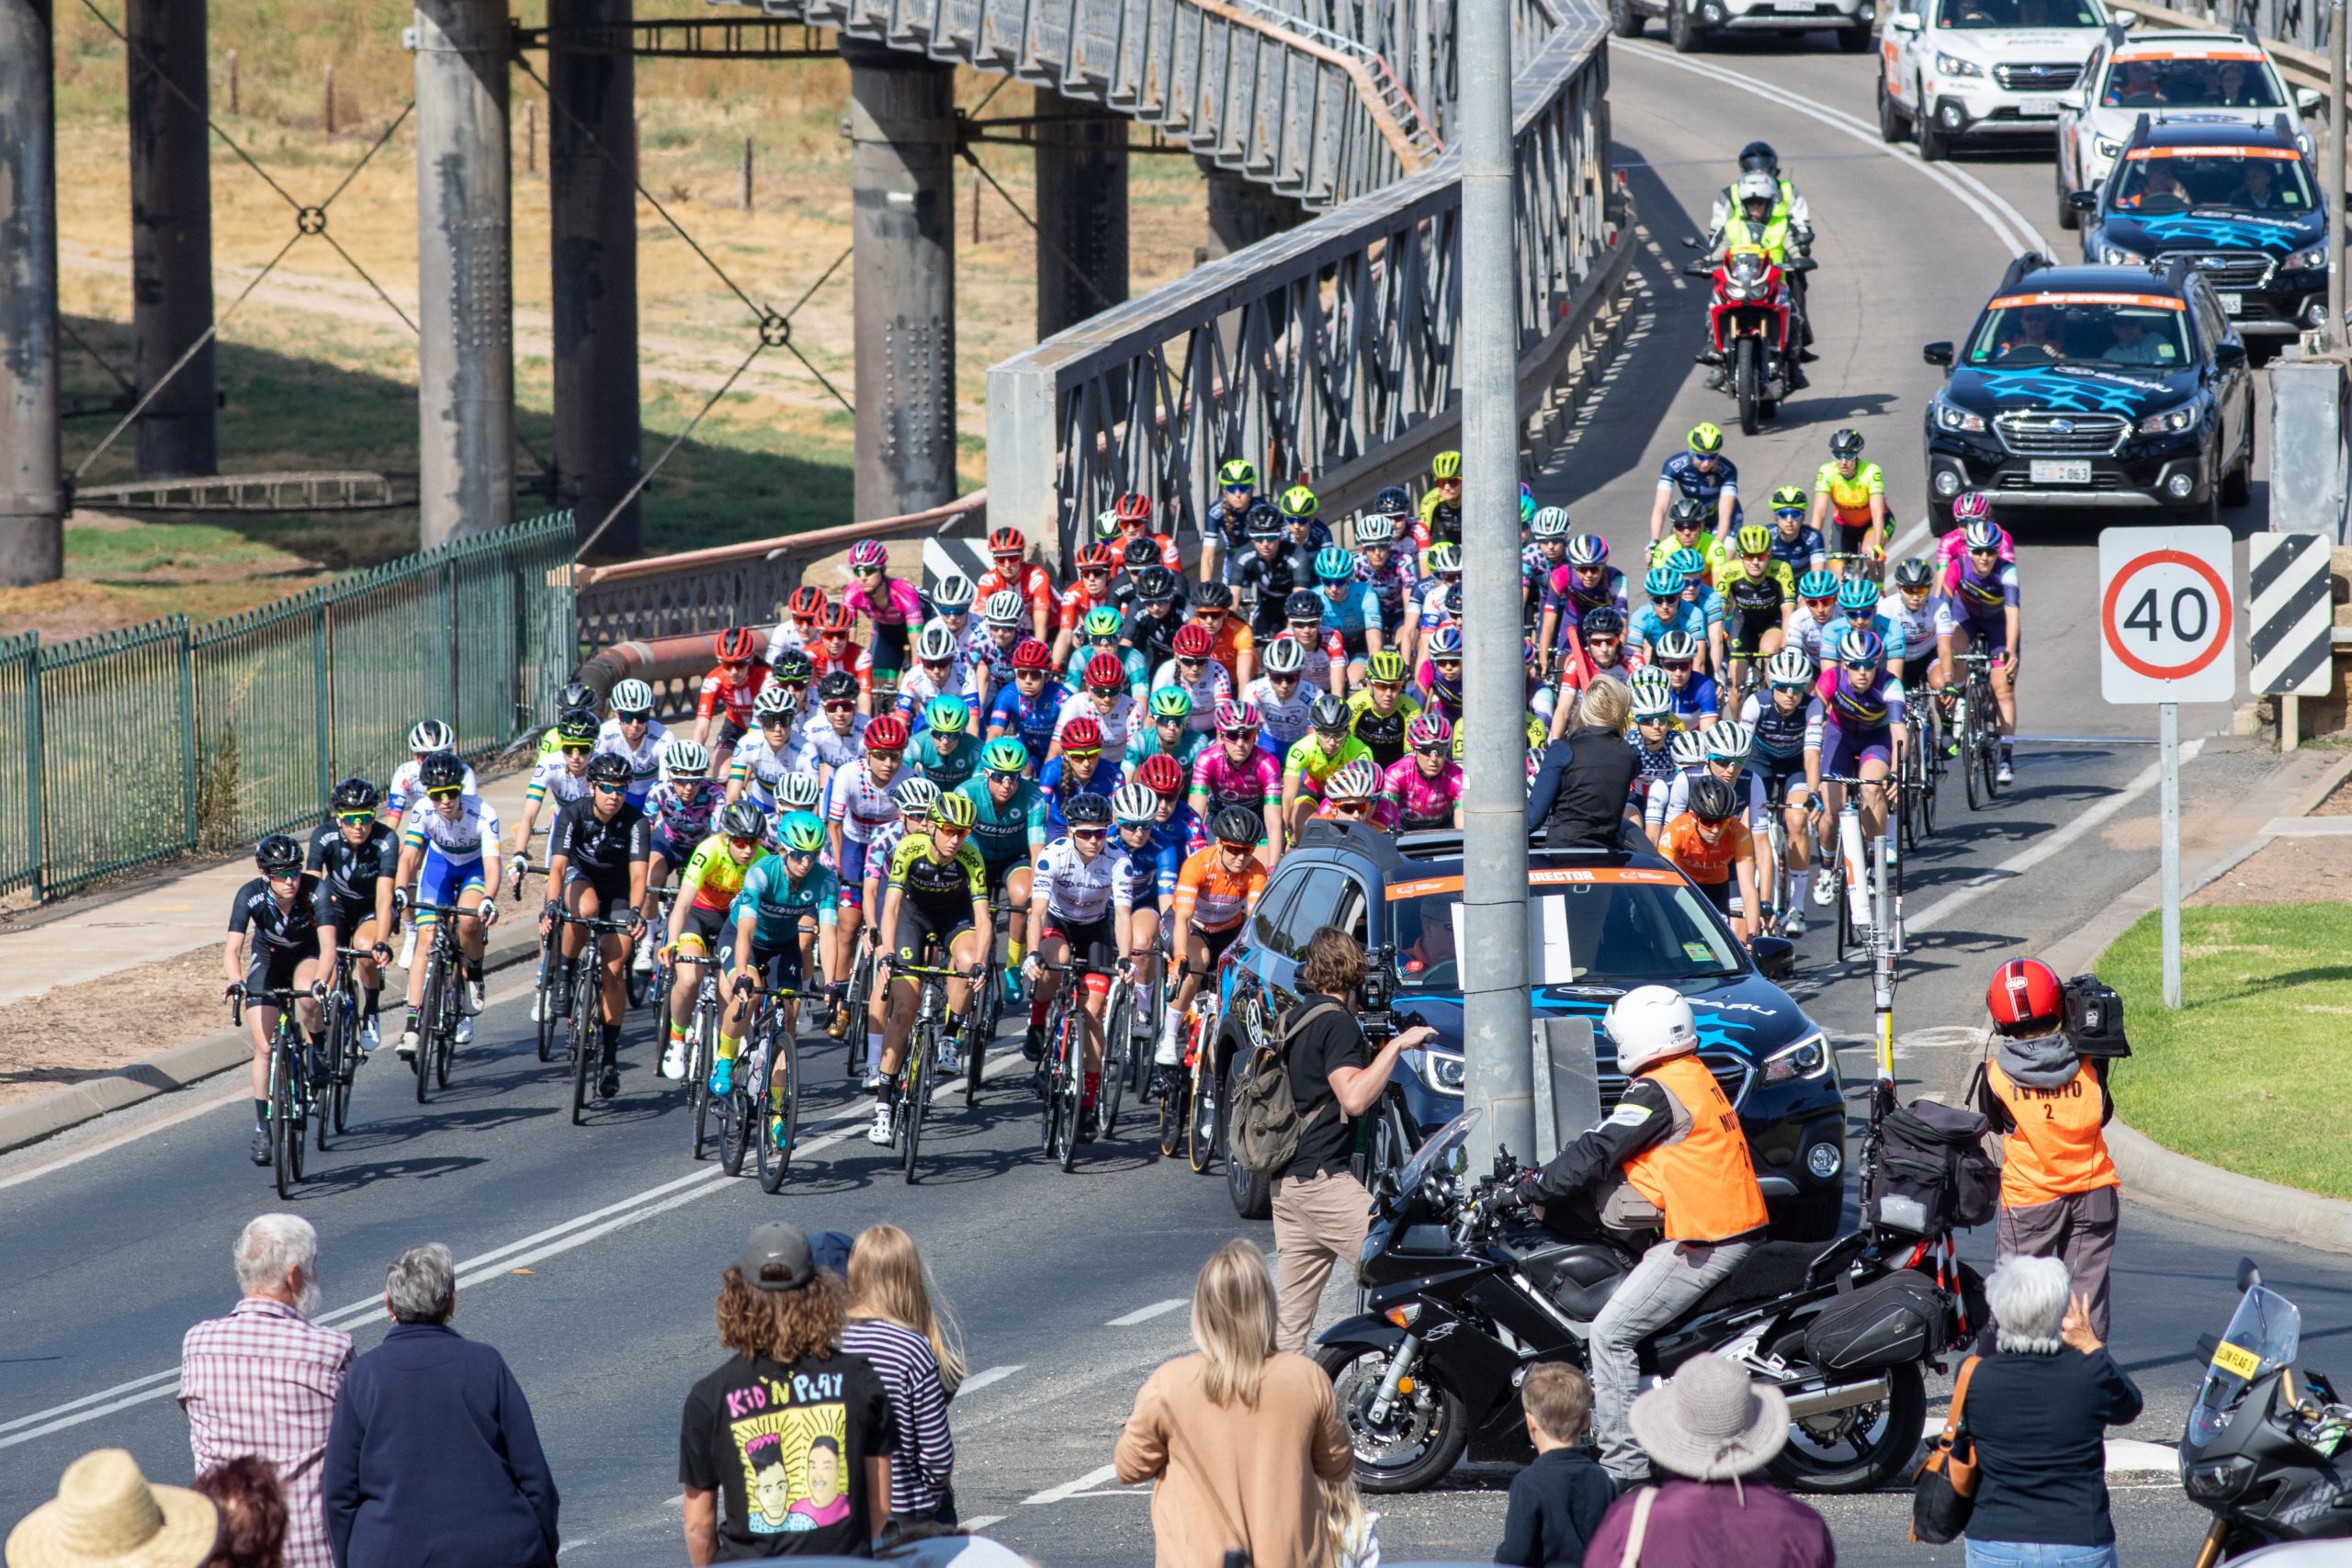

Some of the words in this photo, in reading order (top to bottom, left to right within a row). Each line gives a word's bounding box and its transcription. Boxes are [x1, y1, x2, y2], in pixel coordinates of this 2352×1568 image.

[2095, 372, 2174, 392] SUBARU
[2123, 587, 2208, 642] 40
[1529, 870, 1596, 882] IRECTOR
[1685, 997, 1778, 1016] BARU
[2036, 1079, 2083, 1100] MOTO
[2043, 1103, 2054, 1120] 2
[792, 1372, 843, 1404] PLAY
